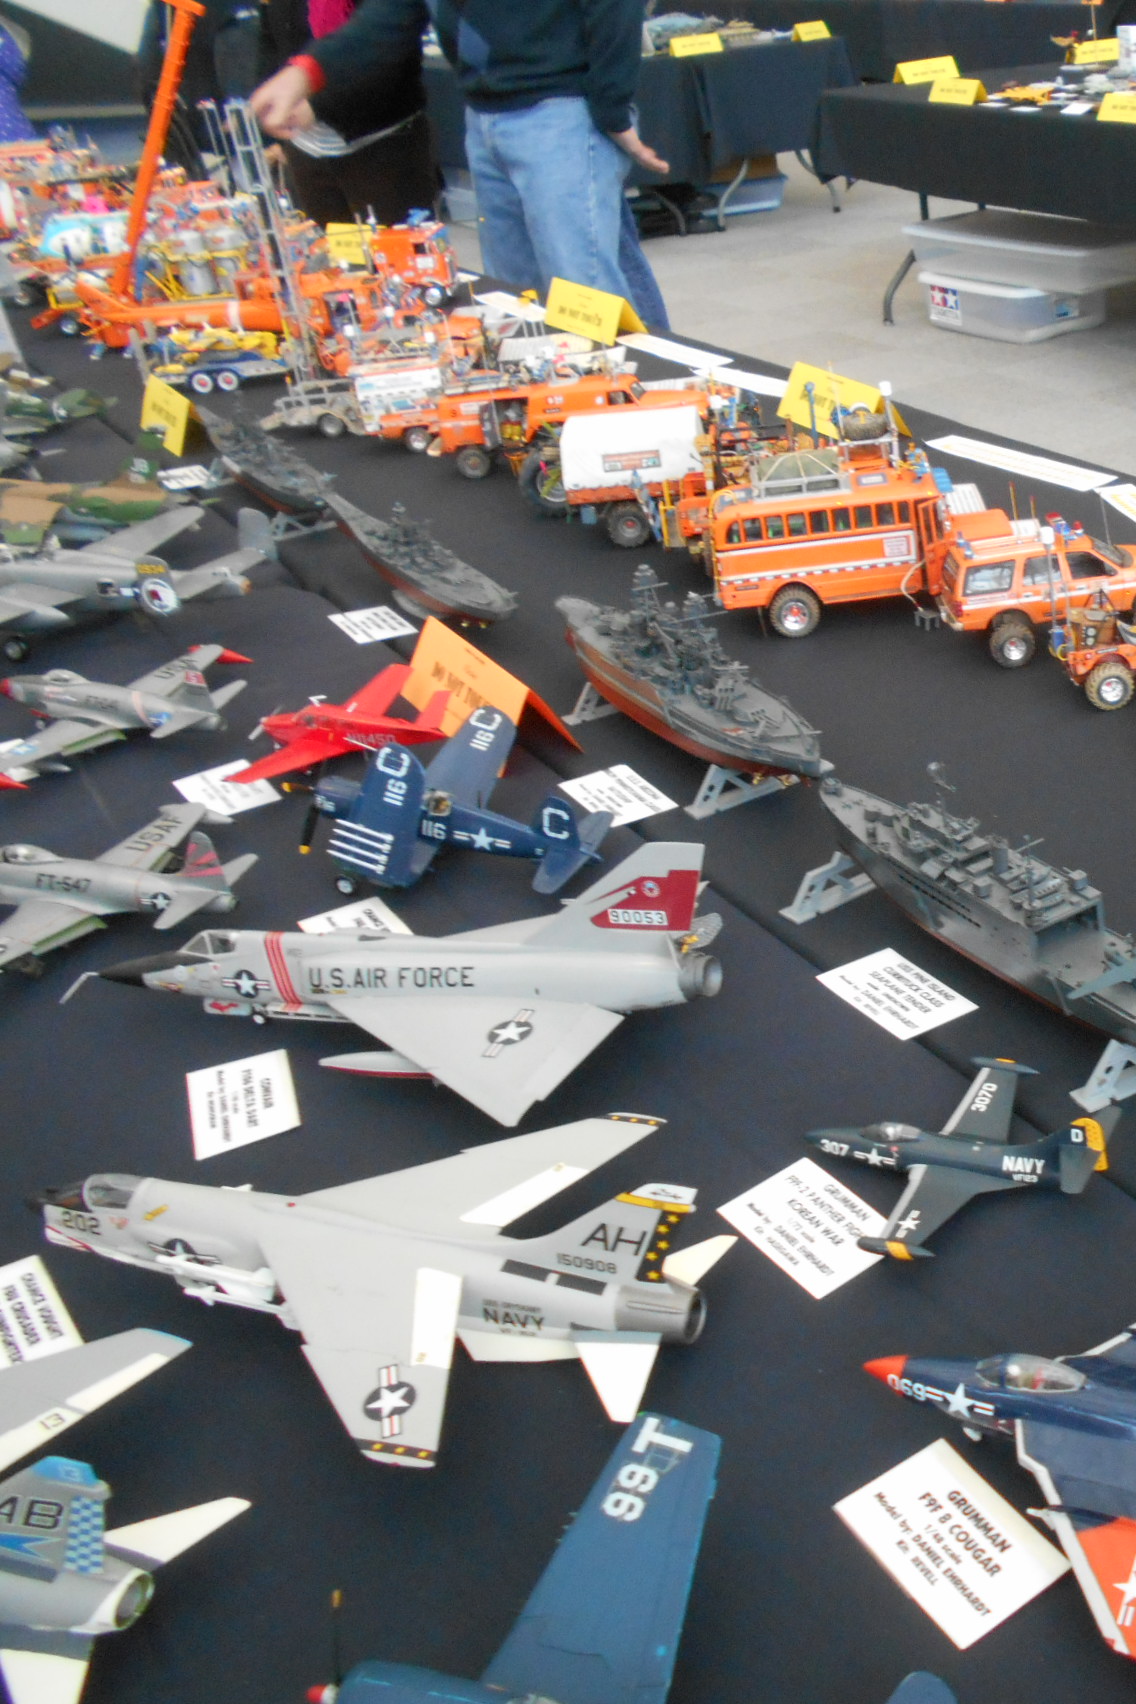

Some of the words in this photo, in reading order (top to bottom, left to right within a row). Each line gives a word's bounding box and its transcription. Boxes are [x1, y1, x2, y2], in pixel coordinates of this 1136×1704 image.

[469, 708, 502, 731] C
[376, 747, 411, 778] C
[126, 817, 184, 852] USAF
[421, 820, 447, 840] 116
[542, 807, 570, 840] C
[610, 910, 665, 924] 90053
[398, 967, 475, 988] FORCE
[868, 970, 906, 996] SEAPLANE
[927, 980, 956, 1001] ISLAND
[919, 990, 945, 1009] CLASS
[820, 1139, 850, 1157] 307
[1002, 1155, 1046, 1174] NAVY
[806, 1192, 846, 1225] PANTHER
[823, 1184, 871, 1222] GRUMMAN
[62, 1210, 101, 1236] 202
[788, 1199, 823, 1229] KOREAN
[821, 1226, 845, 1247] WAR
[581, 1223, 647, 1256] AH
[556, 1253, 619, 1274] 150908
[483, 1308, 545, 1331] NAVY
[886, 1373, 927, 1402] 069
[602, 1463, 659, 1522] 99
[631, 1416, 694, 1454] T
[0, 1496, 63, 1530] AB
[947, 1489, 1013, 1554] GRUMMAN
[918, 1492, 944, 1513] F9F
[949, 1523, 1003, 1578] COUGAR
[874, 1491, 903, 1521] Model
[912, 1534, 945, 1569] DANIEL
[942, 1567, 993, 1618] EHRHARDT
[910, 1556, 939, 1587] REVELL
